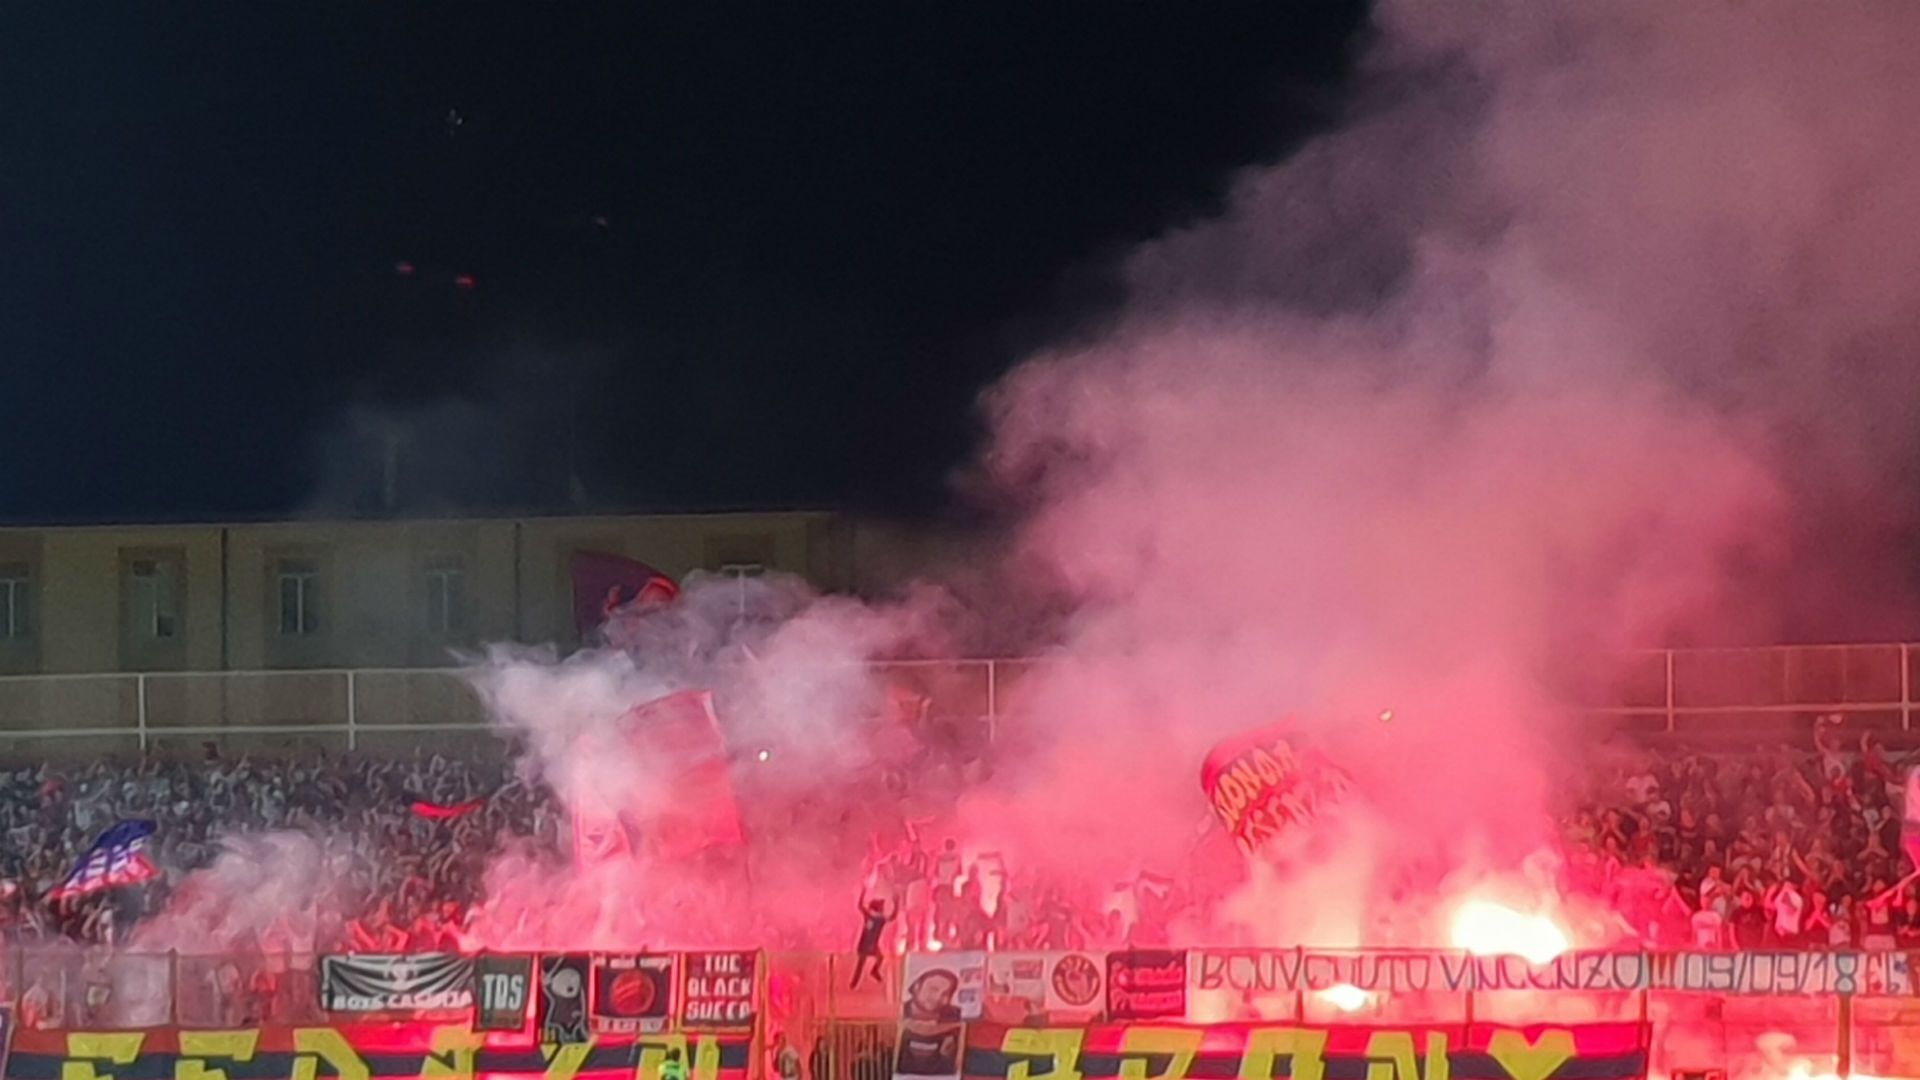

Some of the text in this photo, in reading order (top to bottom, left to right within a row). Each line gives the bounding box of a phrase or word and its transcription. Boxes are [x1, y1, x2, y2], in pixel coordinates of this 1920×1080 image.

[704, 954, 742, 973] THE
[1683, 951, 1859, 994] 09/09/18
[482, 973, 525, 1010] TDS
[686, 977, 752, 997] BLACK
[685, 1001, 752, 1020] SHEEP
